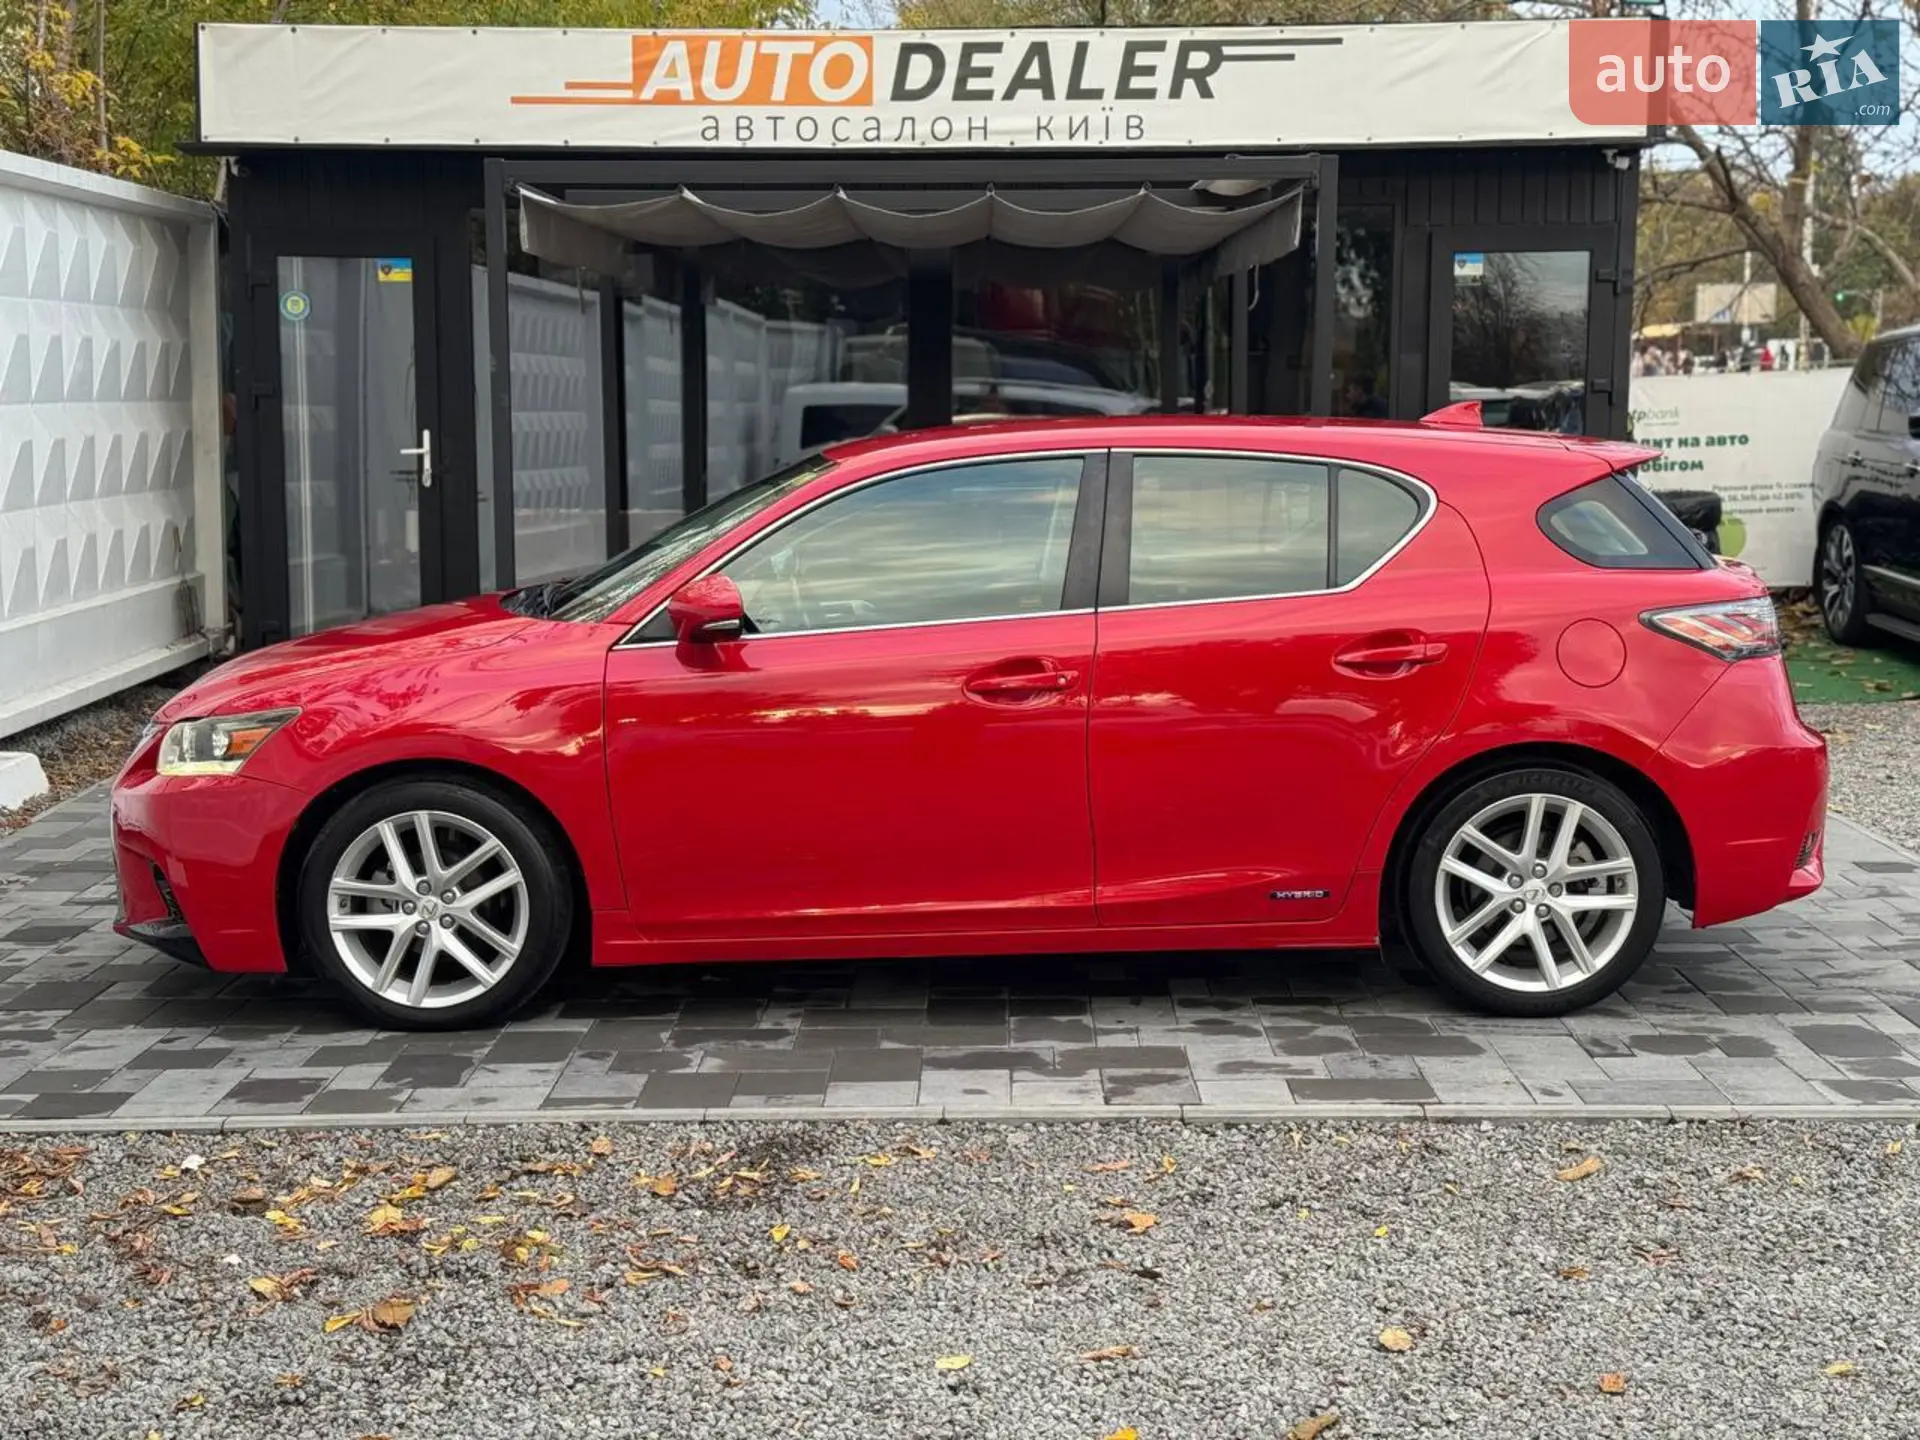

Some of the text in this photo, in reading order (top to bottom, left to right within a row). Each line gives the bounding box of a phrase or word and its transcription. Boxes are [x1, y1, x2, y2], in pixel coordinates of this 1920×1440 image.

[639, 40, 1226, 102] AUTO DEALER
[701, 106, 1146, 143] автосалон київ
[1631, 406, 1680, 423] tpbank
[1640, 434, 1750, 449] дит на авто
[1640, 456, 1705, 472] обігом
